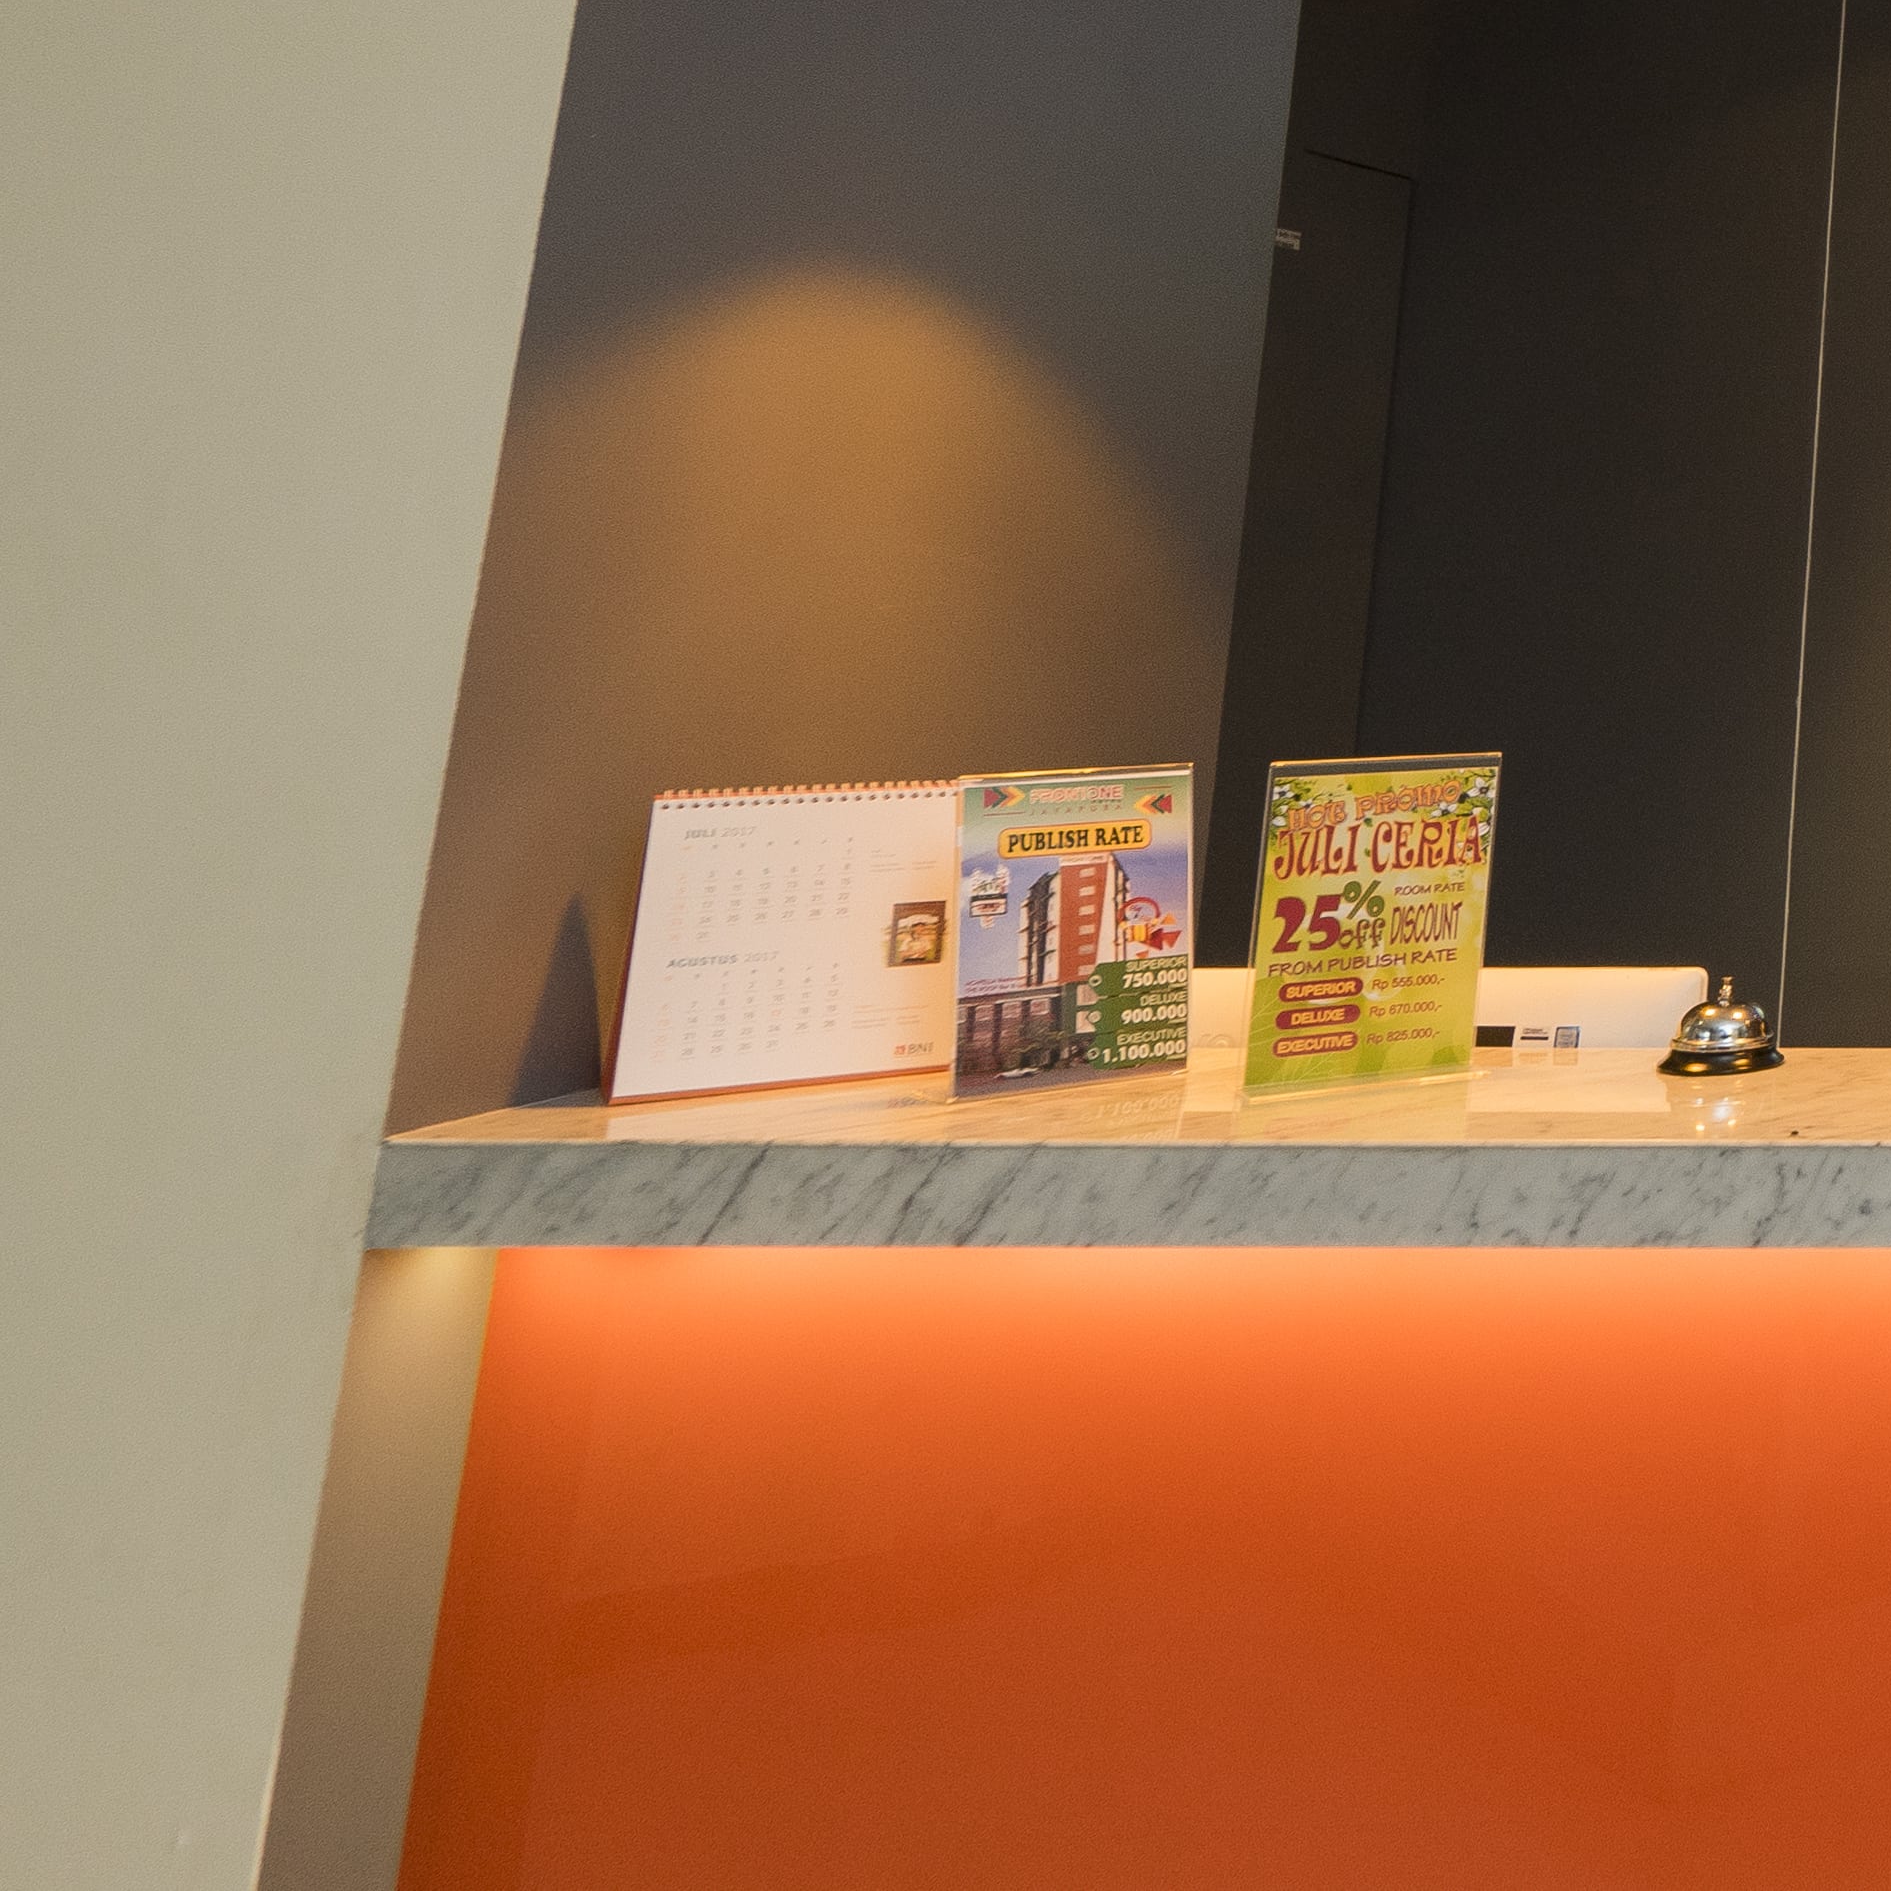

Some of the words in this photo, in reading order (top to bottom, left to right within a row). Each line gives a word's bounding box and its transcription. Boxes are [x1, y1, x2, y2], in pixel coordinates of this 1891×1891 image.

[1287, 799, 1346, 831] HOT
[1354, 779, 1463, 822] PROMO
[1007, 829, 1088, 854] PUBLISH
[1095, 825, 1144, 847] RATE
[1273, 824, 1362, 881] JULI
[1371, 814, 1484, 874] CERIA
[1394, 884, 1432, 897] ROOM
[1434, 881, 1466, 894] RATE
[1390, 901, 1464, 946] DISCOUNT
[1338, 918, 1386, 950] off
[1126, 955, 1187, 972] SUPERIOR
[1268, 960, 1325, 978] FROM
[1328, 952, 1407, 972] PUBLISH
[1411, 947, 1458, 965] RATE
[1122, 967, 1188, 989] 750.000
[1372, 977, 1388, 991] Rp
[1139, 989, 1187, 1007] DELUXE
[1286, 980, 1357, 999] SUPERIOR
[1121, 1003, 1188, 1025] 900.000
[1290, 1008, 1346, 1026] DELUXE
[1369, 1004, 1386, 1018] Rp
[1116, 1026, 1187, 1046] EXECUTIVE
[1276, 1034, 1355, 1054] EXECUTIVE
[1366, 1032, 1383, 1046] Rp
[908, 1042, 935, 1055] BNI
[1102, 1040, 1187, 1065] 1.100.000
